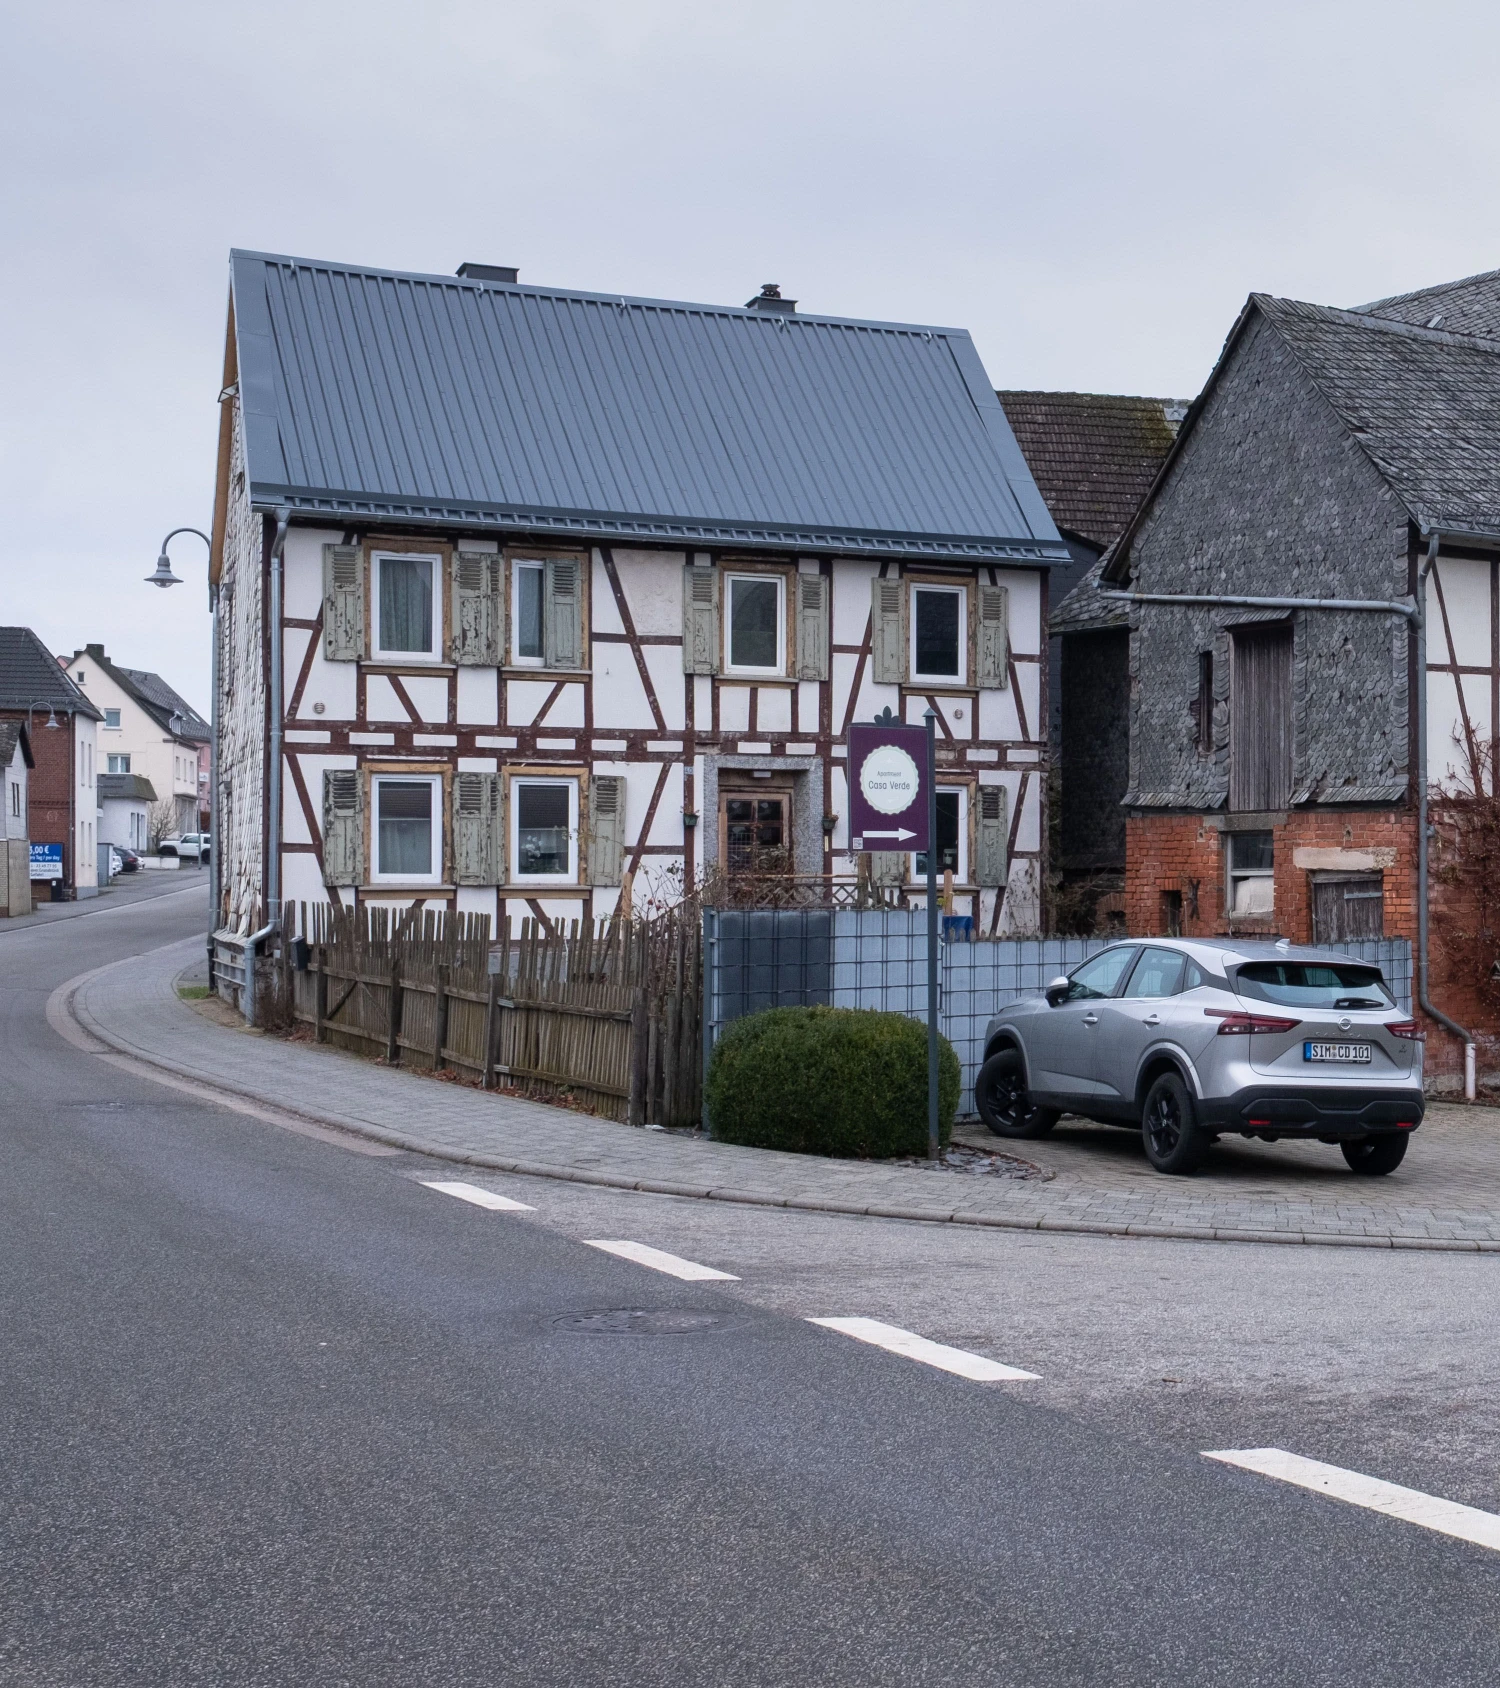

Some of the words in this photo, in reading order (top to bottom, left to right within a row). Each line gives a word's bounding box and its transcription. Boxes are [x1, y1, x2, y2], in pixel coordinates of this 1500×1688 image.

[868, 780, 887, 790] Casa
[890, 780, 911, 790] Verde
[44, 845, 50, 854] €
[1312, 1045, 1331, 1058] SIM
[1338, 1046, 1350, 1059] CD
[1352, 1047, 1370, 1059] 101
